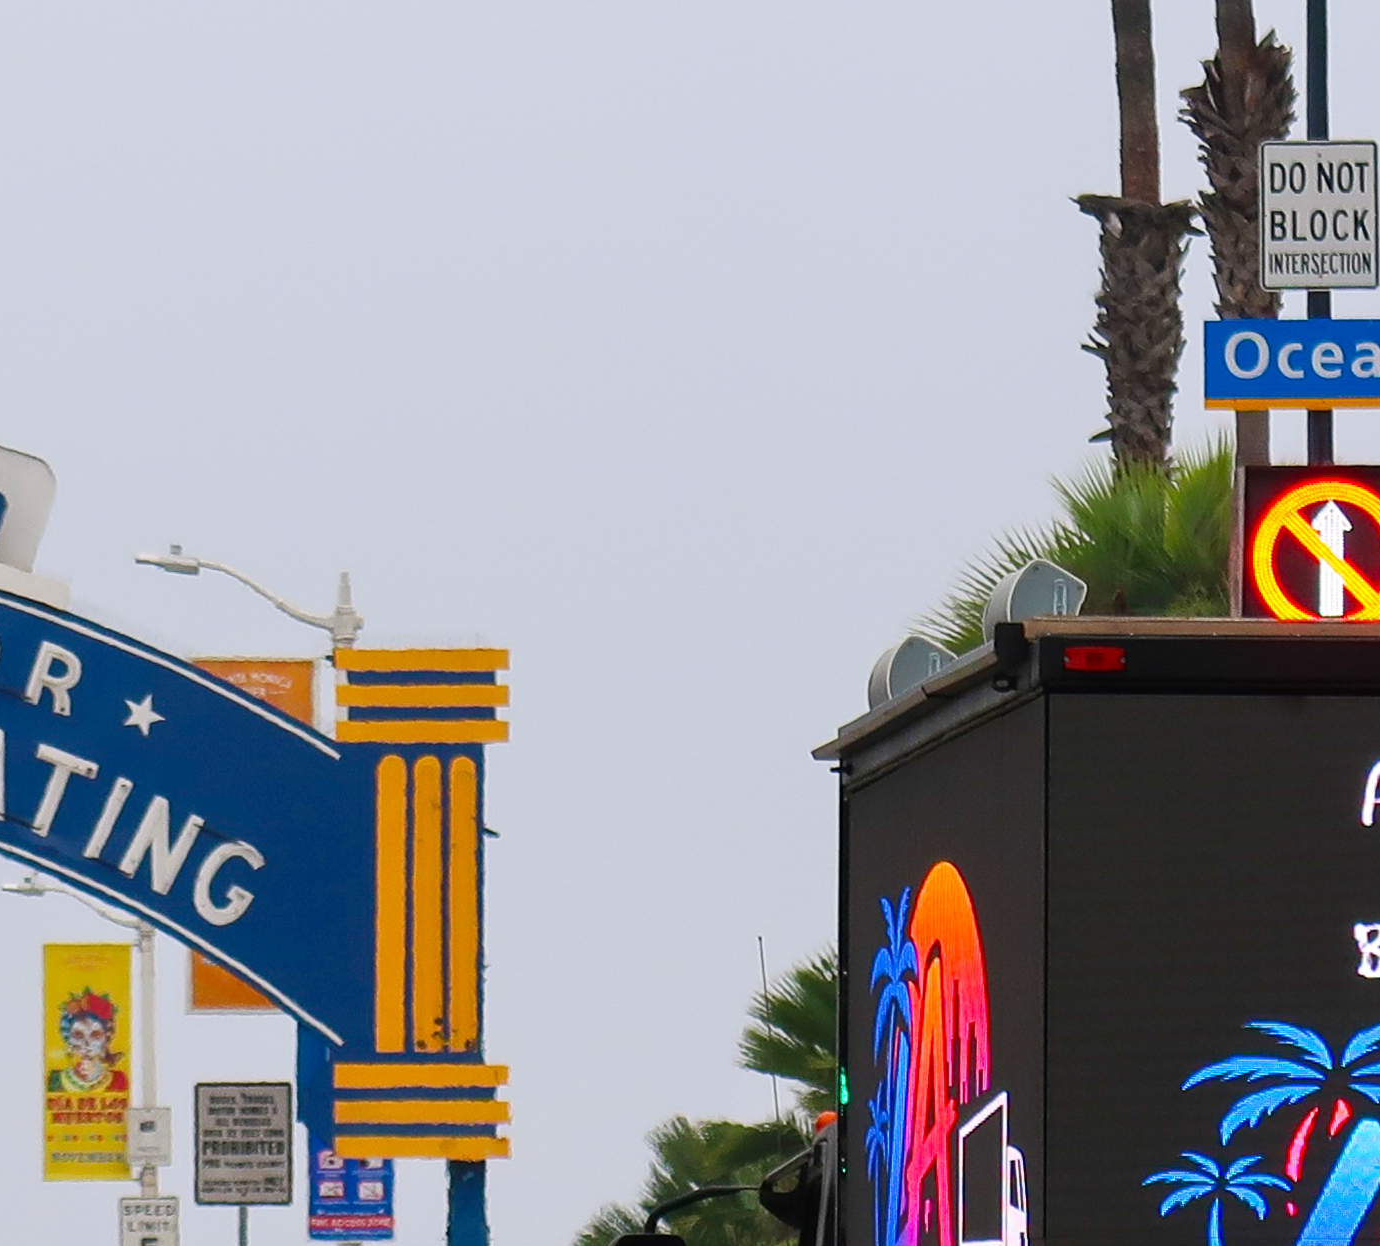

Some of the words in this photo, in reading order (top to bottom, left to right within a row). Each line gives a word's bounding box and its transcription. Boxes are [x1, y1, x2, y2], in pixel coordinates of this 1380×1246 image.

[1270, 162, 1306, 194] DO
[1317, 162, 1369, 194] NOT
[1270, 209, 1371, 242] BLOCK
[1269, 252, 1372, 275] INTERSECTION
[202, 1140, 284, 1155] PROHIBITED
[124, 1205, 175, 1216] SPEED
[127, 1221, 171, 1232] LIMIT
